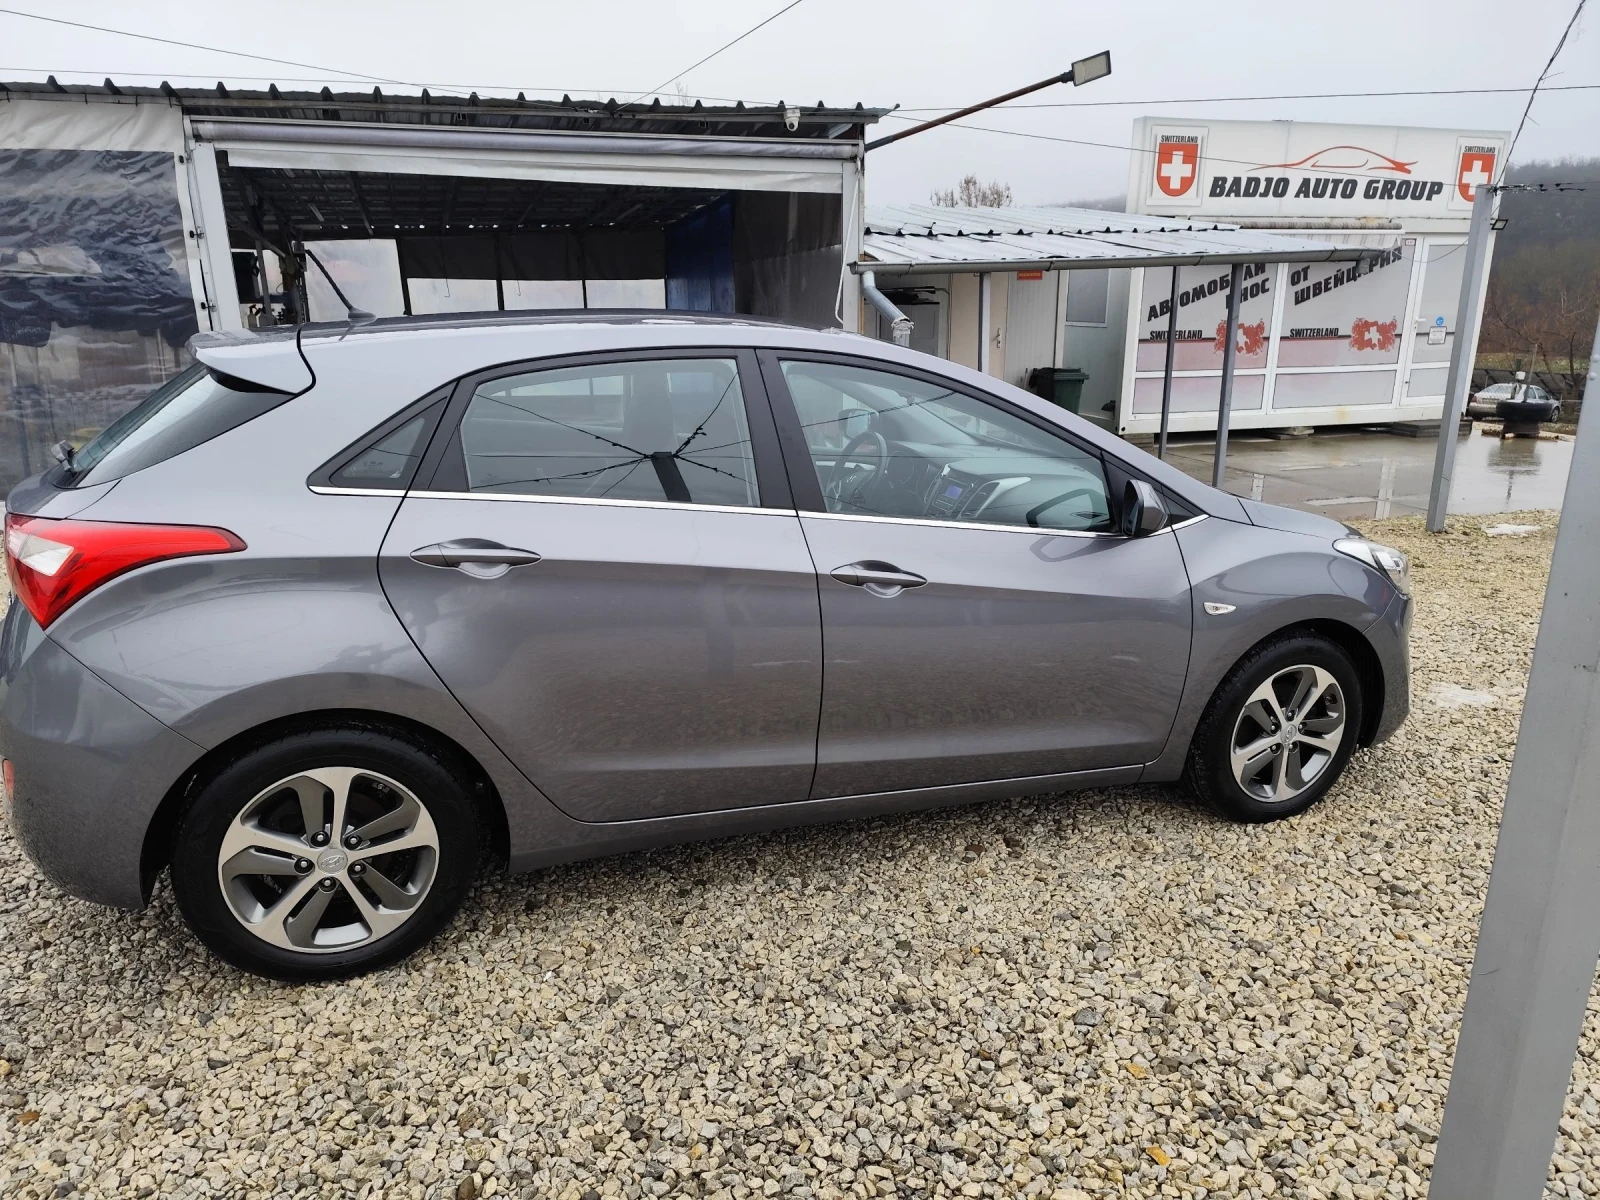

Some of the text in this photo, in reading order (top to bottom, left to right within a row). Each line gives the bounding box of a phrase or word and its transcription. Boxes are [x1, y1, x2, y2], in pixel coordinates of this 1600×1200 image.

[1160, 134, 1199, 144] SWITZERLAND
[1464, 145, 1496, 154] SWITZERLAND
[1209, 176, 1444, 201] BADJO AUTO GROUP
[1290, 264, 1311, 287] ОТ
[1294, 246, 1402, 306] ШВЕЙЦРИЯ
[1147, 263, 1266, 322] АВОМОБЛИ
[1149, 329, 1203, 341] SWITERLAND
[1289, 327, 1339, 338] SWITZERLAND
